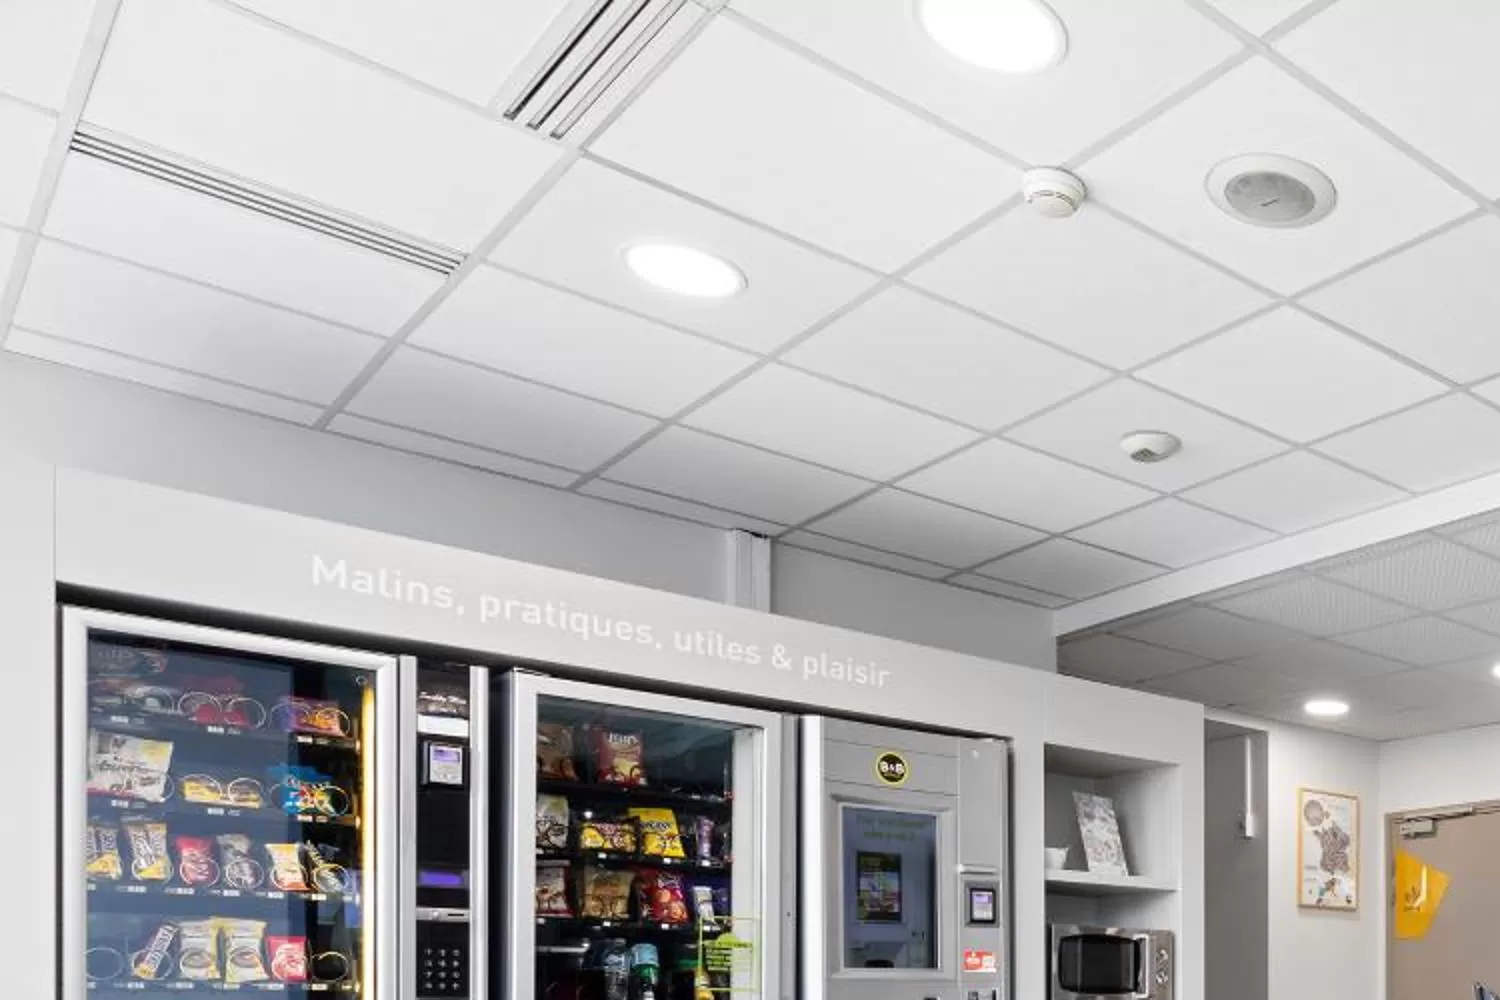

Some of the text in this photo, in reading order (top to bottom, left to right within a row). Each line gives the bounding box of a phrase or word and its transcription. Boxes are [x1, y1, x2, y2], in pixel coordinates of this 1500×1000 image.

[311, 553, 893, 688] Malins, pratiques, utiles & plaisir
